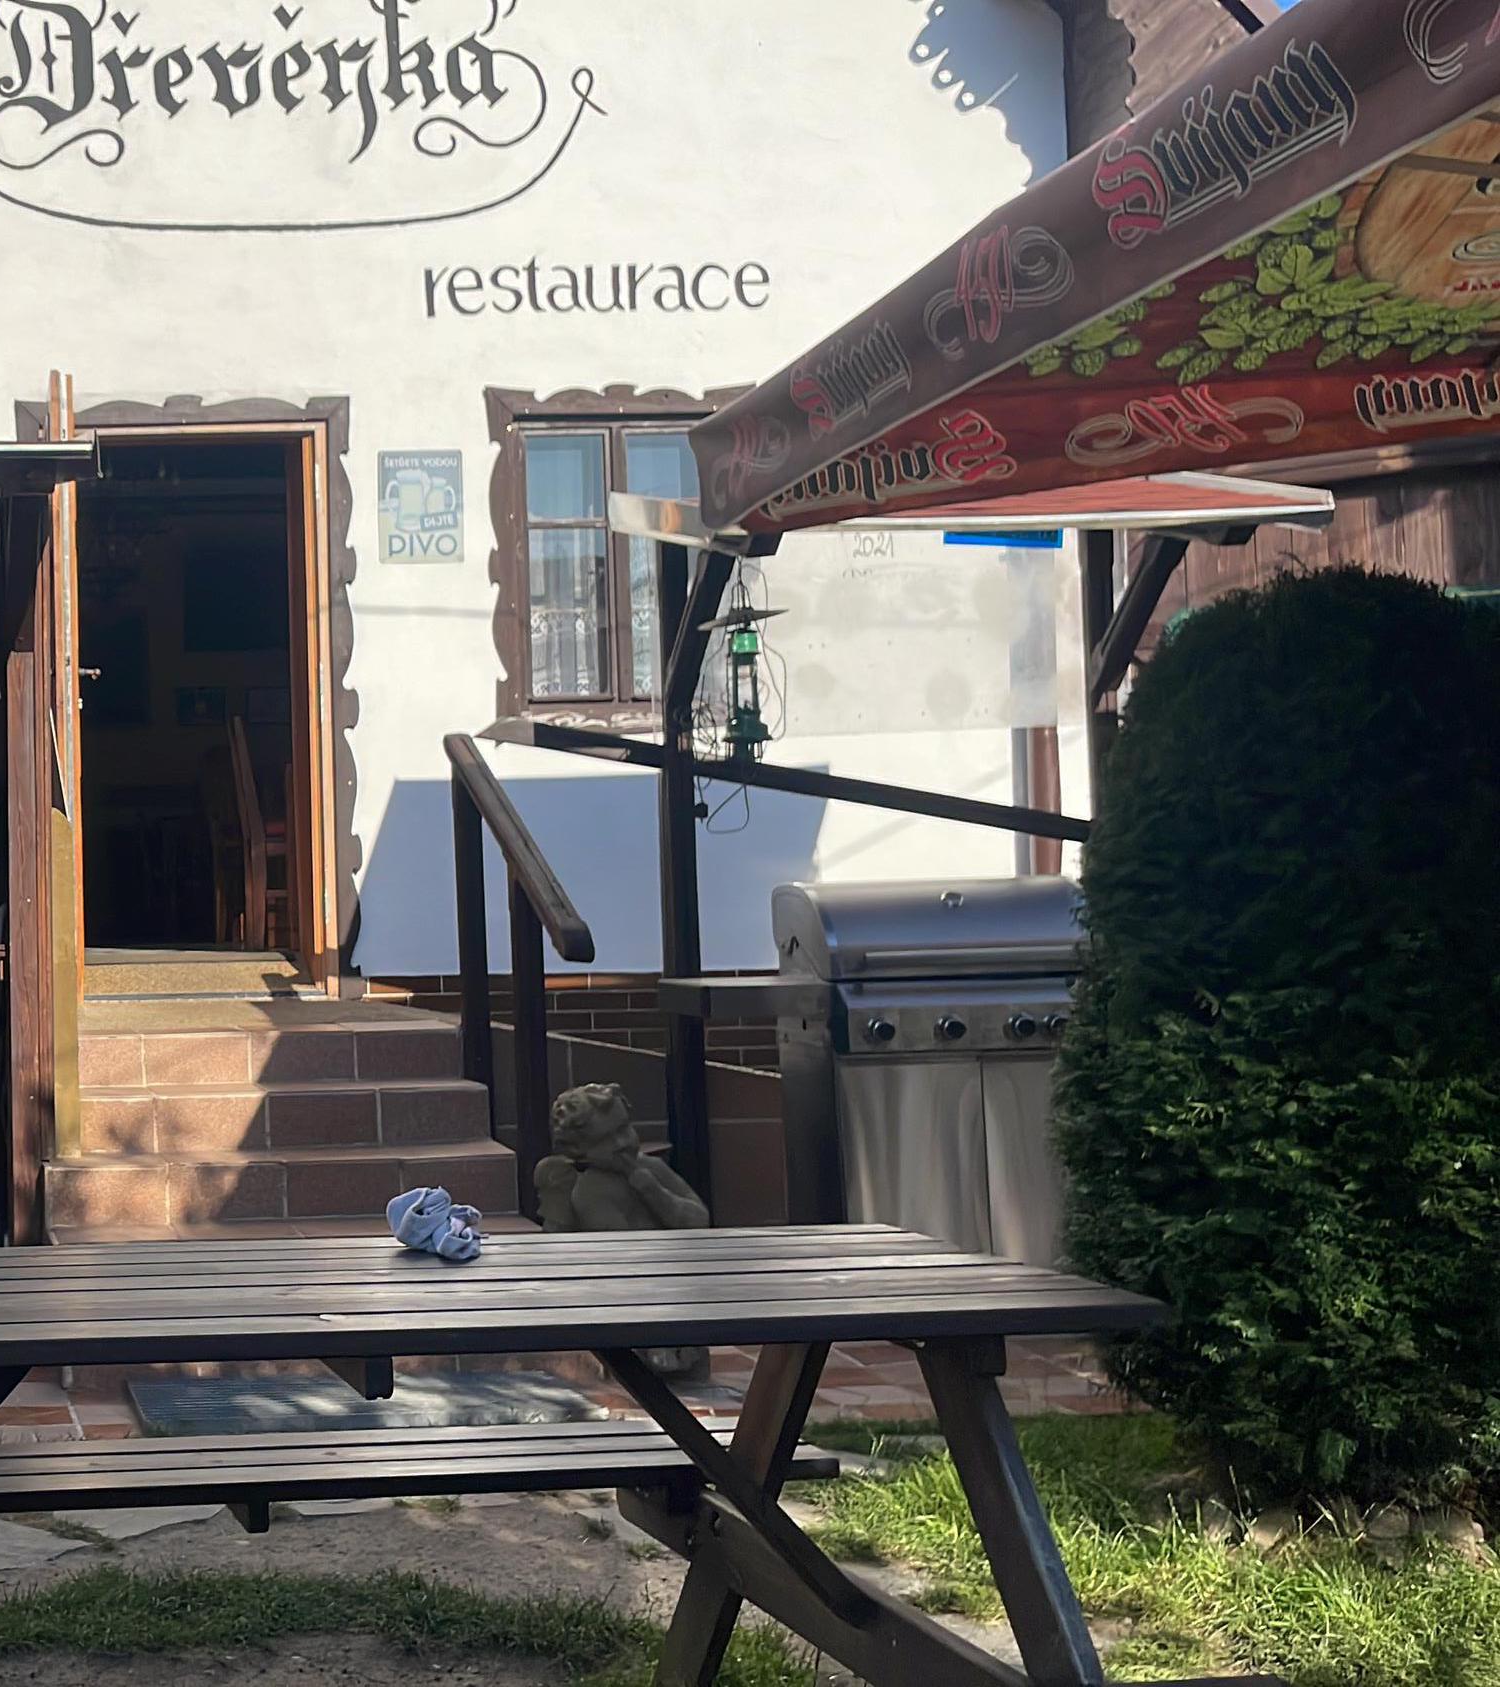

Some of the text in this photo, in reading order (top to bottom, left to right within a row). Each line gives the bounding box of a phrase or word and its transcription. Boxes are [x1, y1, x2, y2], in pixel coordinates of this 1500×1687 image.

[1092, 38, 1357, 250] Svijany
[424, 258, 771, 317] restaurace
[388, 533, 457, 557] PIVO
[852, 531, 894, 559] 2021
